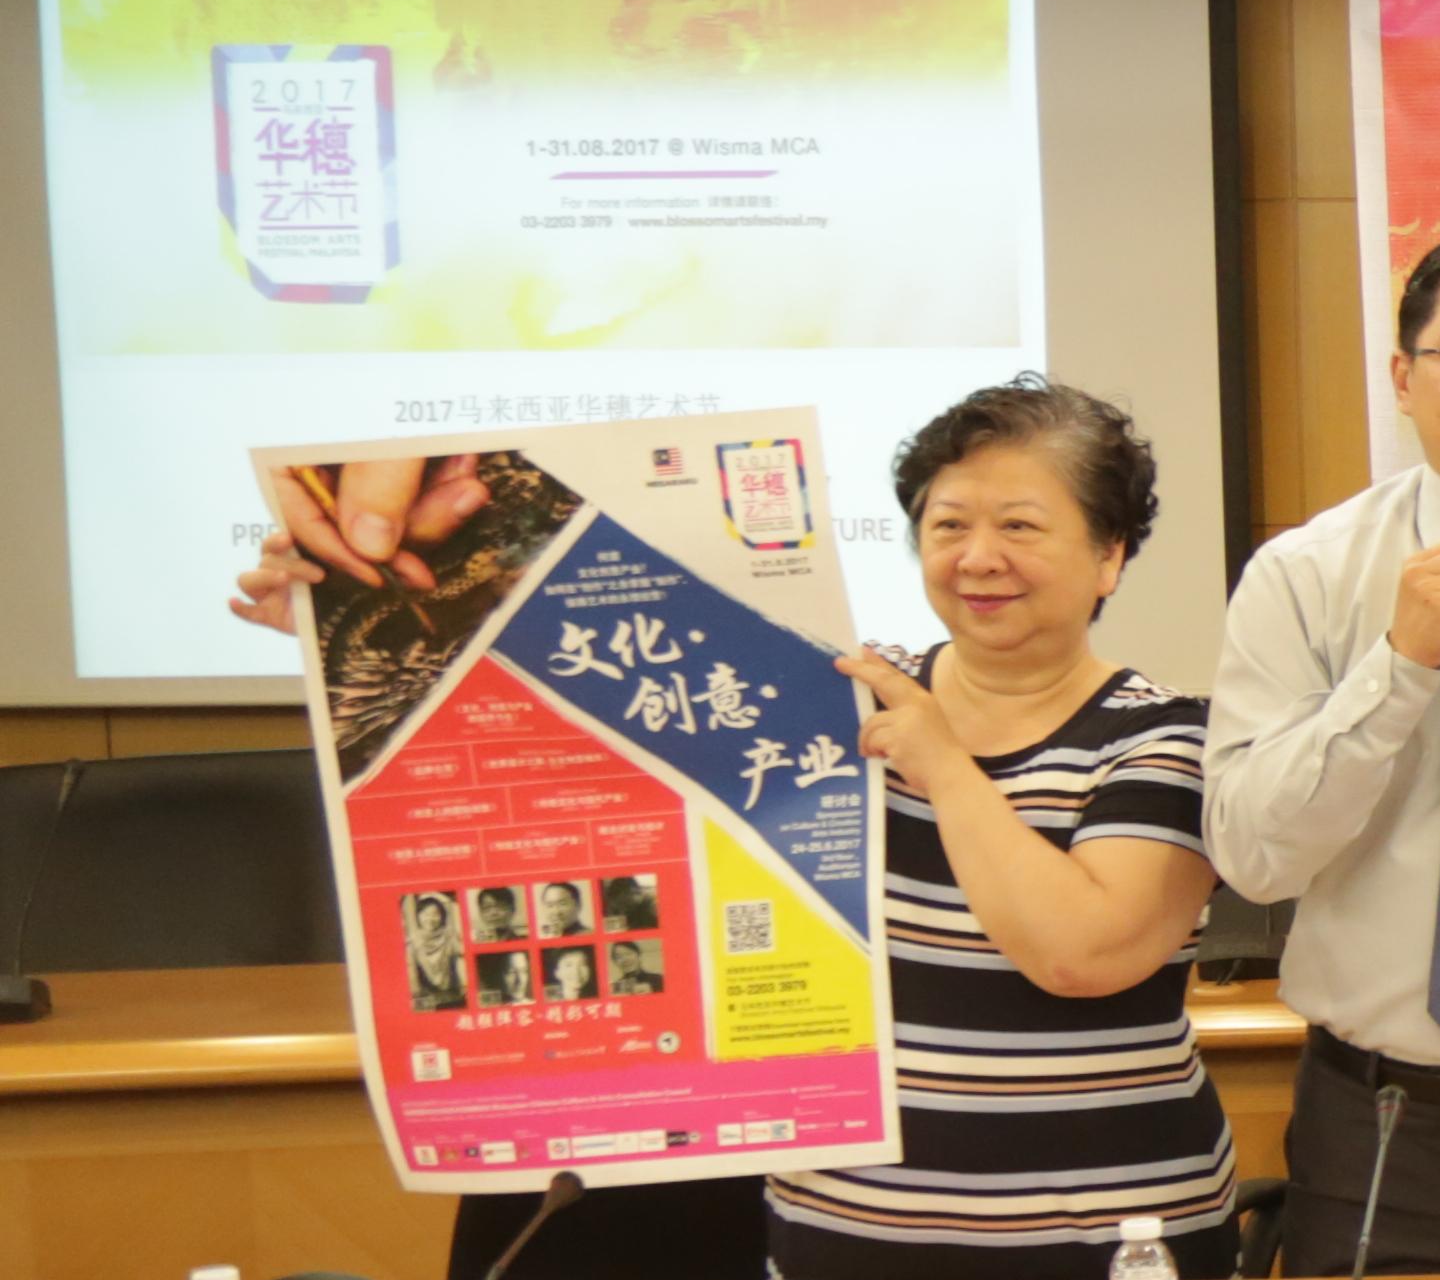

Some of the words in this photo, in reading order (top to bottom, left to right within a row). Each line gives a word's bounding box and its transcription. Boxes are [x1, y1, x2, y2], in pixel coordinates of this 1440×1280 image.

[252, 78, 357, 105] 2017
[256, 116, 358, 177] 华穗
[525, 138, 660, 158] 1-31.08.2017
[691, 137, 764, 157] Wisma
[770, 136, 821, 156] MCA
[740, 735, 860, 812] 产业
